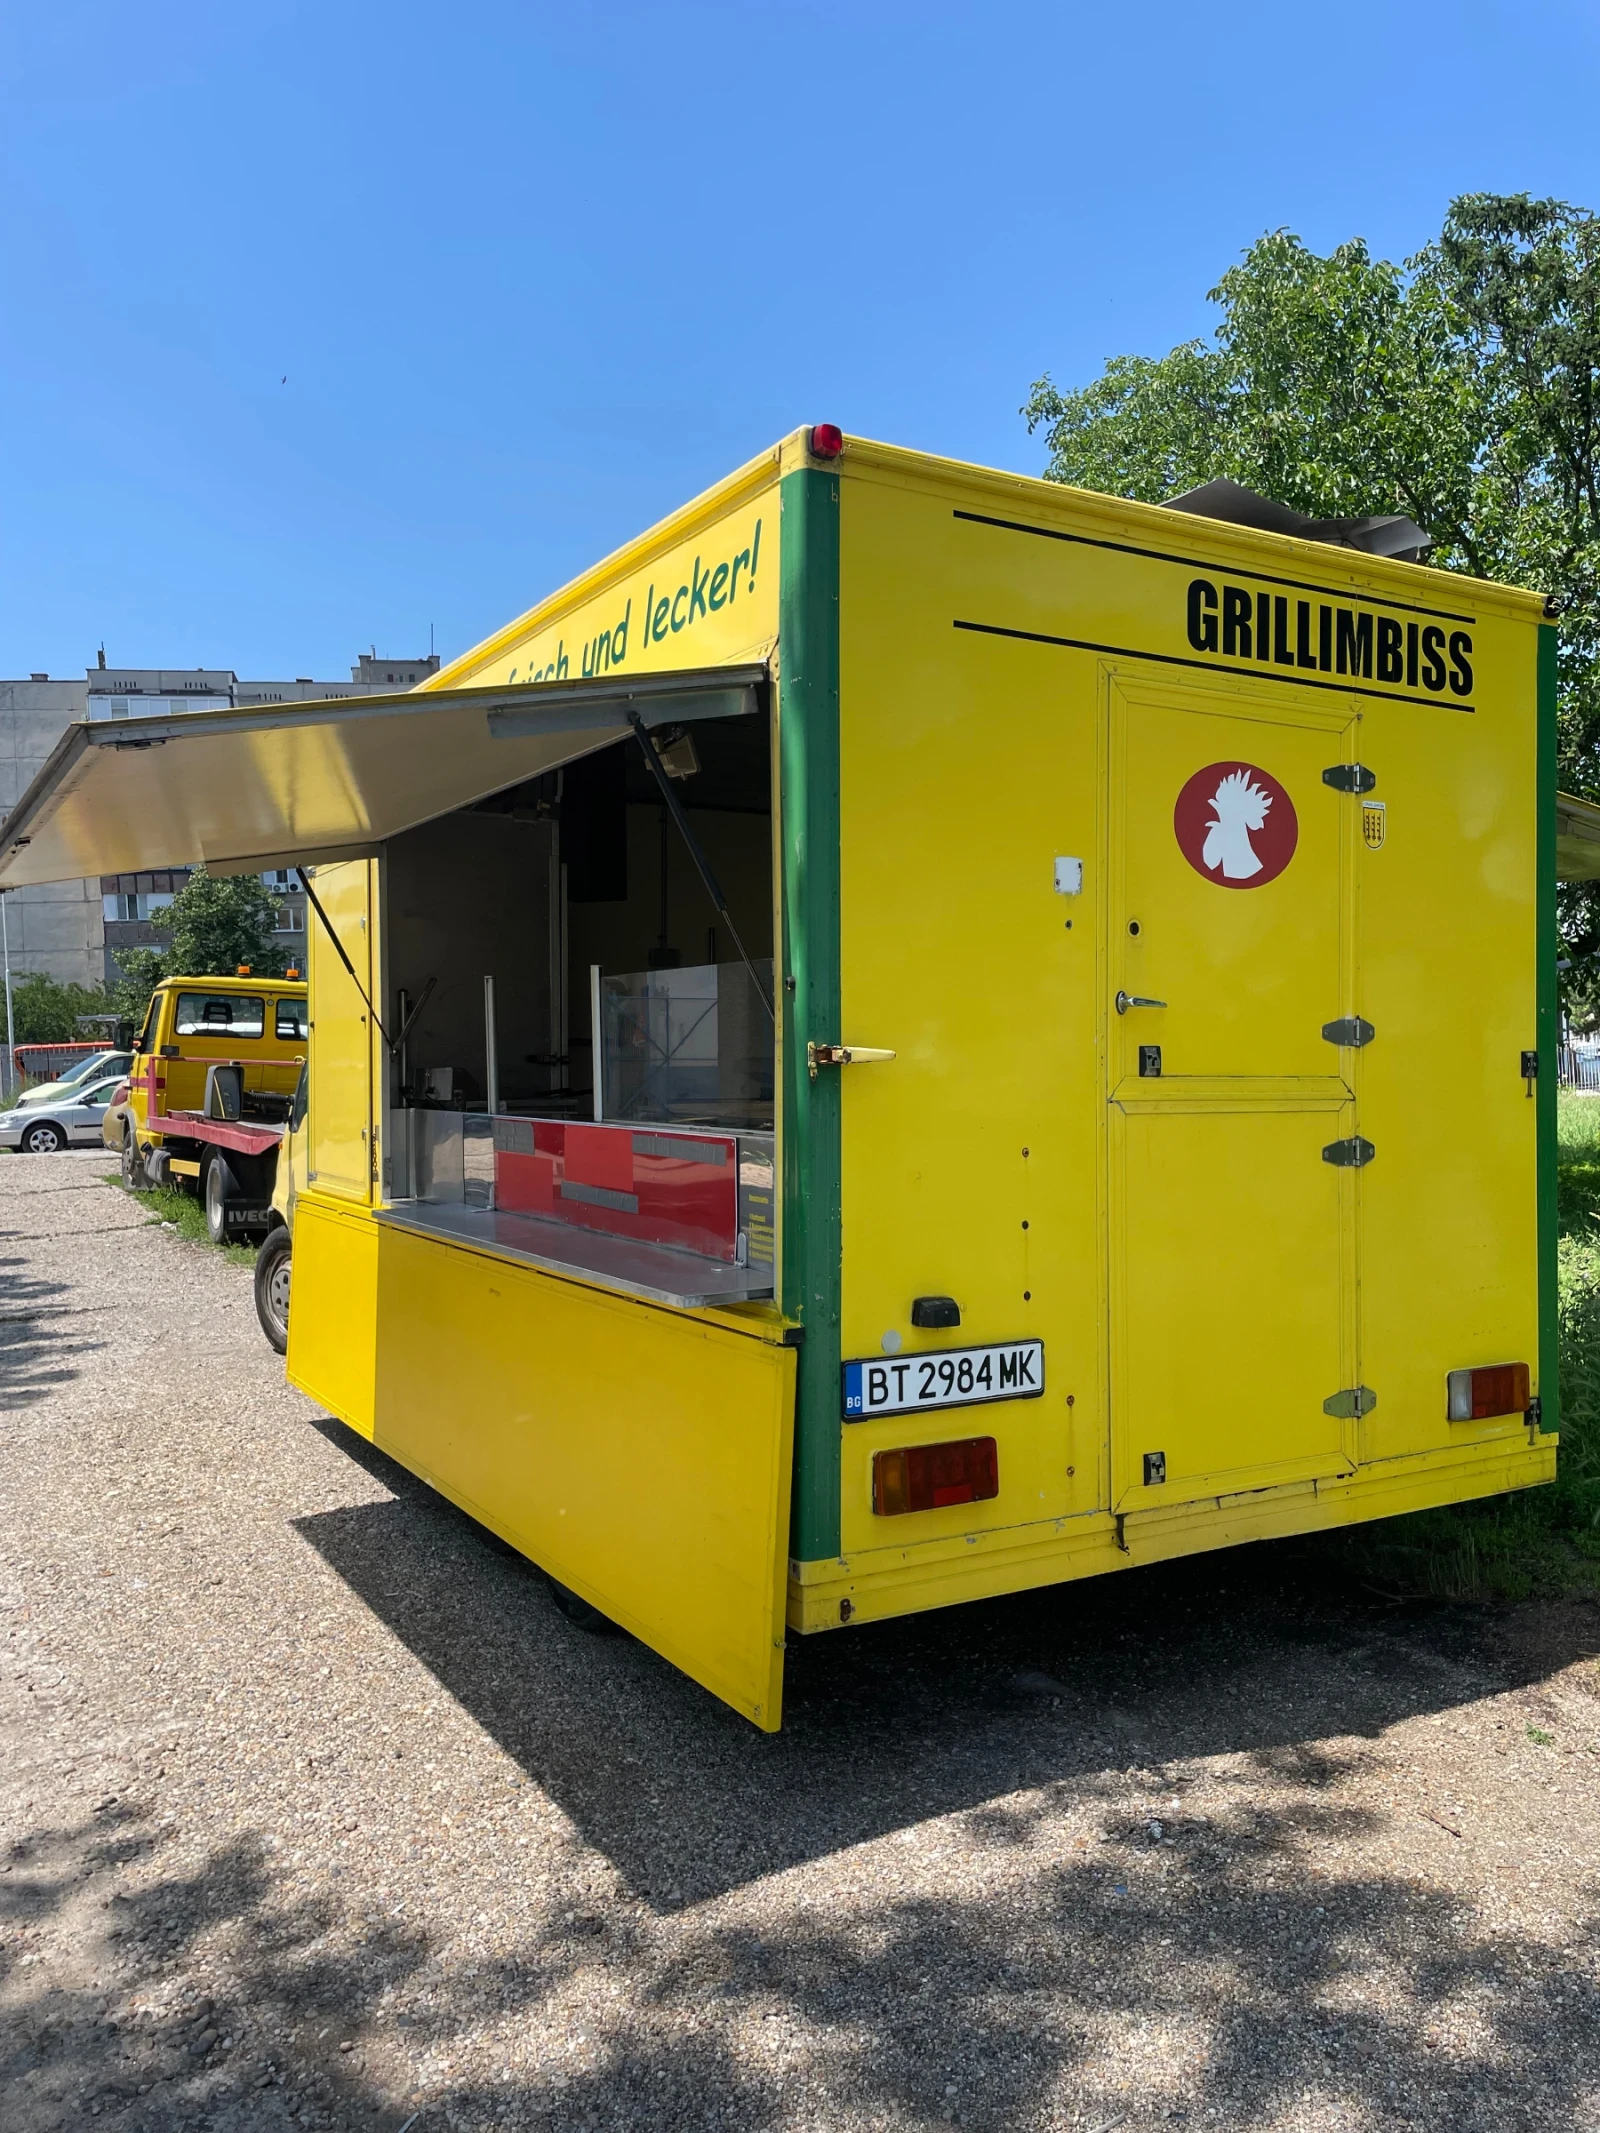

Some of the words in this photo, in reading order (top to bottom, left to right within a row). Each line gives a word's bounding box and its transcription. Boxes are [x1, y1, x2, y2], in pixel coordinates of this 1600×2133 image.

[582, 598, 631, 677] und
[644, 518, 762, 649] lecker!
[1187, 579, 1474, 696] GRILLIMBISS
[846, 1396, 861, 1408] BG
[869, 1364, 910, 1406] BT
[918, 1354, 993, 1400] 2984
[1000, 1349, 1036, 1389] MK
